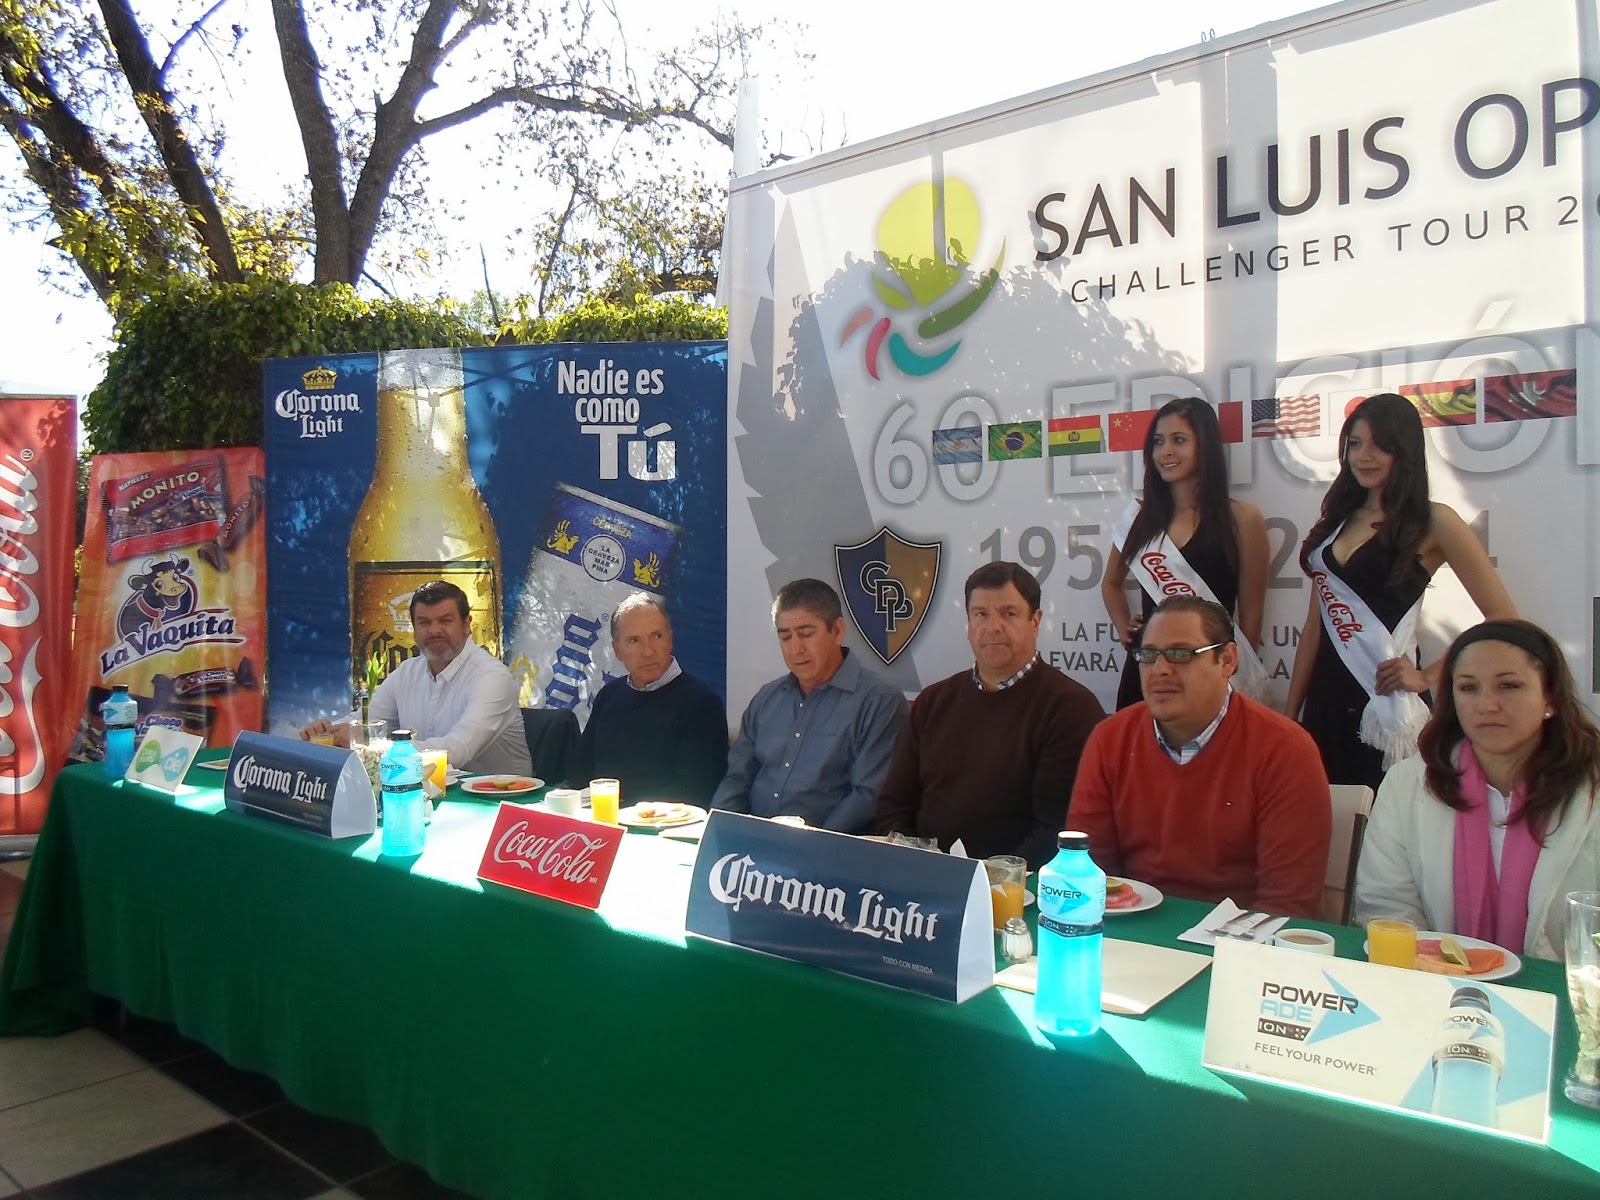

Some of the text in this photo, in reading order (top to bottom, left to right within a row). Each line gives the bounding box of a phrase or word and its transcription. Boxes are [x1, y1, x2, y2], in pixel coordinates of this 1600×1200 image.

[1035, 168, 1176, 262] SAN
[1216, 116, 1410, 229] LUIS
[1071, 193, 1600, 303] CHALLENGER TOUR 2
[558, 359, 664, 395] Nadie es
[275, 388, 360, 421] Corona
[575, 397, 640, 424] como
[299, 414, 344, 438] Light
[581, 422, 677, 481] Tú
[874, 396, 999, 504] 60
[118, 473, 149, 492] NATILLAS
[131, 471, 200, 510] MONITO
[222, 500, 250, 539] MONITO
[588, 547, 620, 565] CERVEZA
[591, 563, 608, 575] FINA
[1312, 569, 1364, 643] Coca-Cola
[101, 613, 234, 675] La Vaquita
[1062, 622, 1088, 642] LA
[145, 715, 183, 727] Choco
[234, 755, 328, 803] Corona Light
[494, 821, 609, 884] Coca-Cola
[708, 852, 938, 944] Corona Light
[882, 955, 934, 975] TODO CON MEDIDA
[1259, 998, 1313, 1023] ADE
[1262, 981, 1359, 1015] POWER
[1258, 1020, 1288, 1035] ION
[1254, 1042, 1375, 1076] FEEL YOUR POWER
[1447, 1045, 1471, 1054] ION
